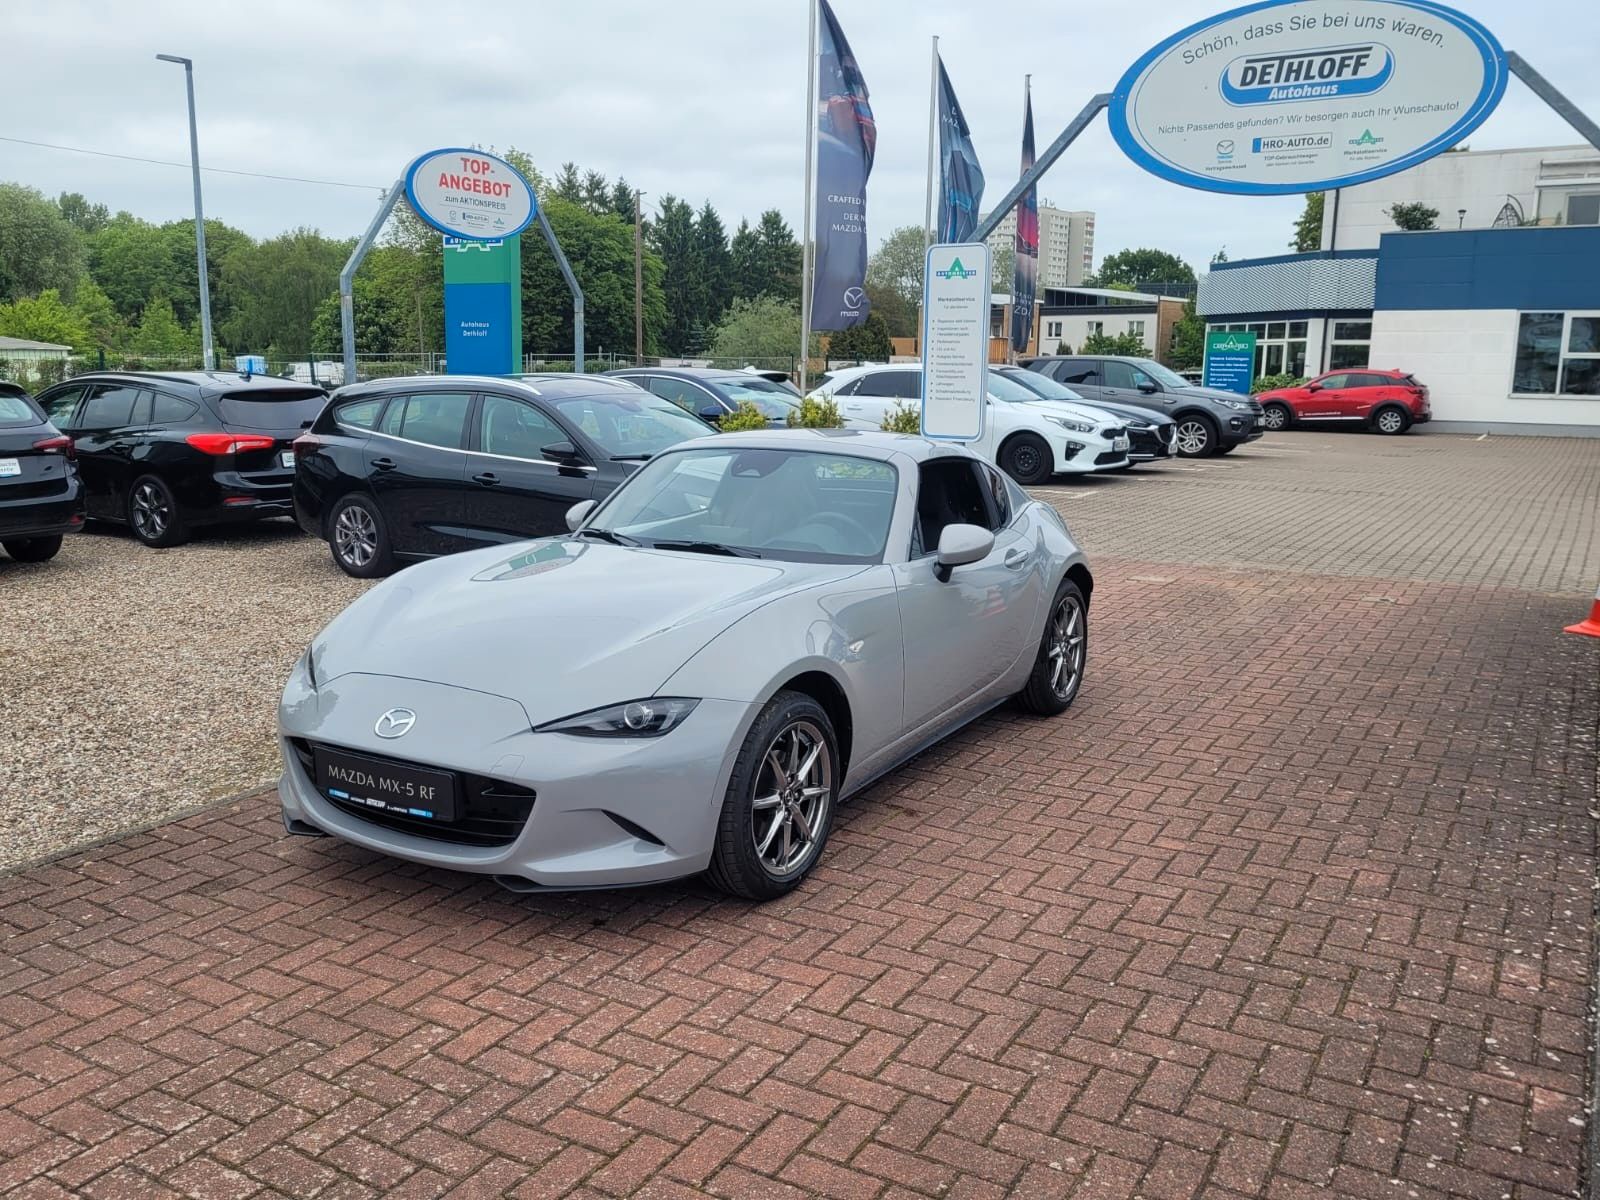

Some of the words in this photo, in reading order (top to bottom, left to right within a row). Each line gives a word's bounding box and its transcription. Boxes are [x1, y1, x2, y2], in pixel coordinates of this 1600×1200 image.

[1182, 35, 1239, 65] Schön,
[1244, 24, 1284, 42] dass
[1289, 15, 1317, 31] Sie
[1322, 12, 1348, 28] bei
[1354, 14, 1386, 29] uns
[1391, 18, 1445, 48] waren.
[1239, 46, 1373, 87] DETHLOFF
[1268, 83, 1338, 100] Autohaus
[1158, 124, 1185, 134] Nichts
[1186, 120, 1235, 133] Passendes
[1236, 115, 1284, 129] gefunden?
[1286, 113, 1303, 124] Wir
[1304, 110, 1349, 122] besorgen
[1351, 108, 1375, 119] auch
[1378, 106, 1391, 116] Ihr
[1393, 100, 1460, 116] Wunschauto!
[1262, 136, 1329, 150] HRO-AUTO.de
[460, 156, 496, 175] TOP-
[439, 172, 512, 198] ANGEBOT
[445, 195, 459, 204] zum
[459, 196, 507, 210] AKTIONSPREIS
[827, 194, 861, 205] CRAFTED
[843, 212, 860, 222] DER
[831, 223, 863, 233] MAZDA
[460, 320, 490, 328] Autohaus
[328, 764, 376, 789] MAZDA
[379, 776, 415, 797] MX-5
[420, 785, 437, 800] RF
